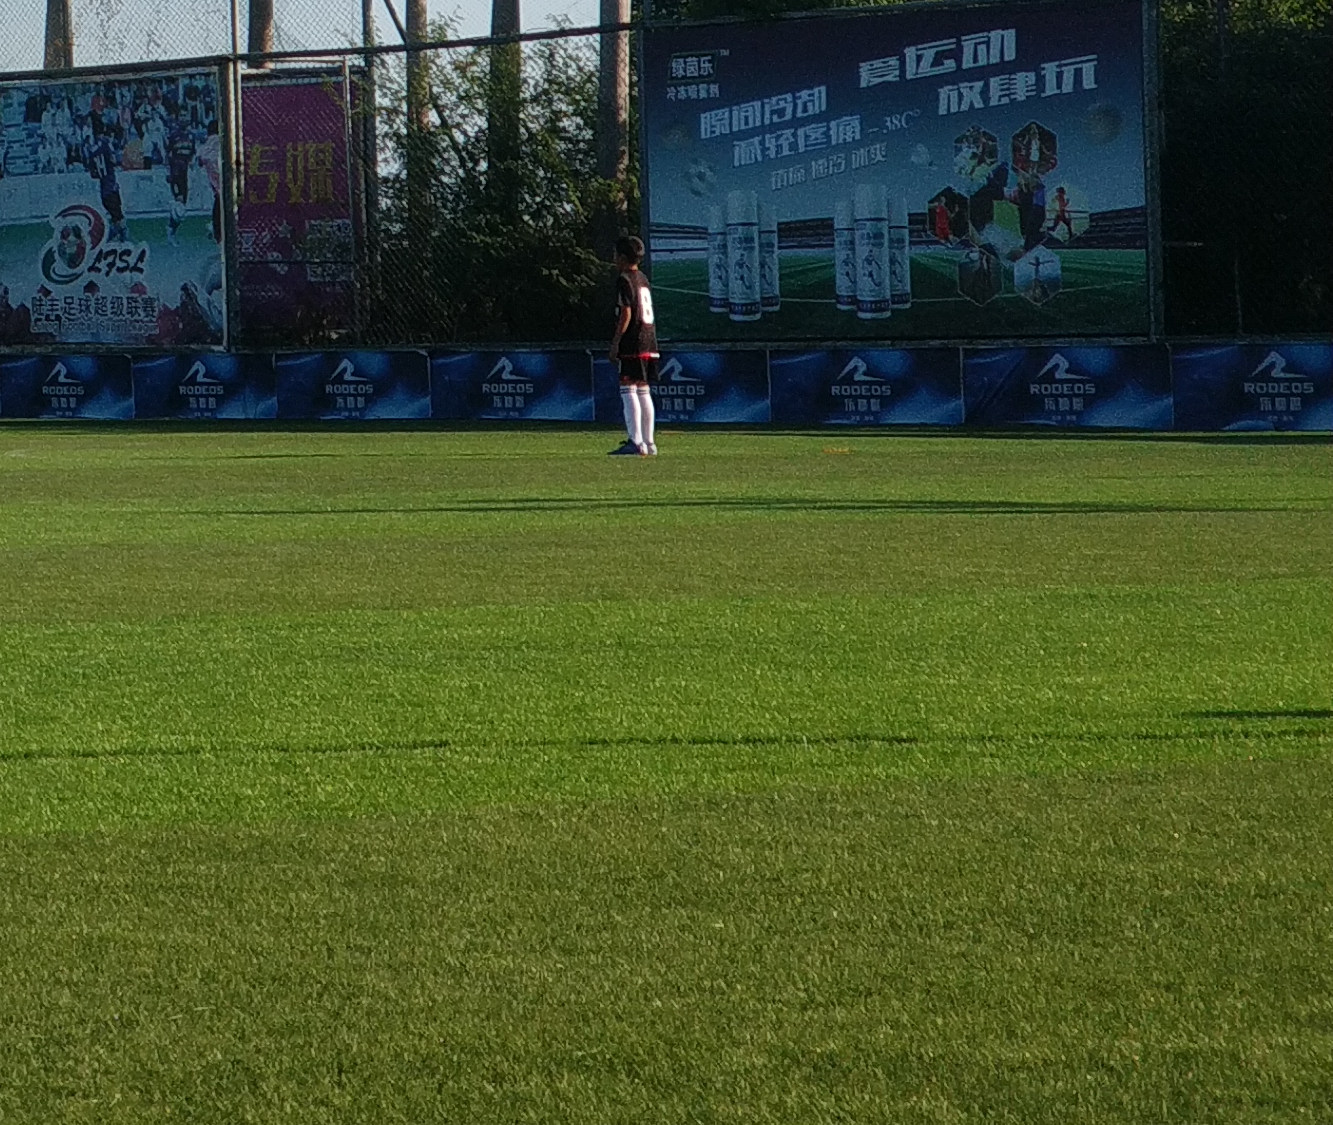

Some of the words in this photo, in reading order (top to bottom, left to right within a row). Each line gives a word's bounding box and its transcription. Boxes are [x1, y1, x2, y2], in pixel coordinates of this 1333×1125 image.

[858, 28, 1017, 89] 爱运动
[671, 55, 714, 79] 绿茵乐
[700, 86, 828, 140] 瞬间冷却
[639, 286, 654, 324] 8
[325, 384, 374, 394] RODEOS
[482, 383, 534, 393] RODEOS
[831, 385, 891, 396] RODEOS
[1030, 383, 1096, 394] RODEOS
[1243, 382, 1315, 394] RODEOS
